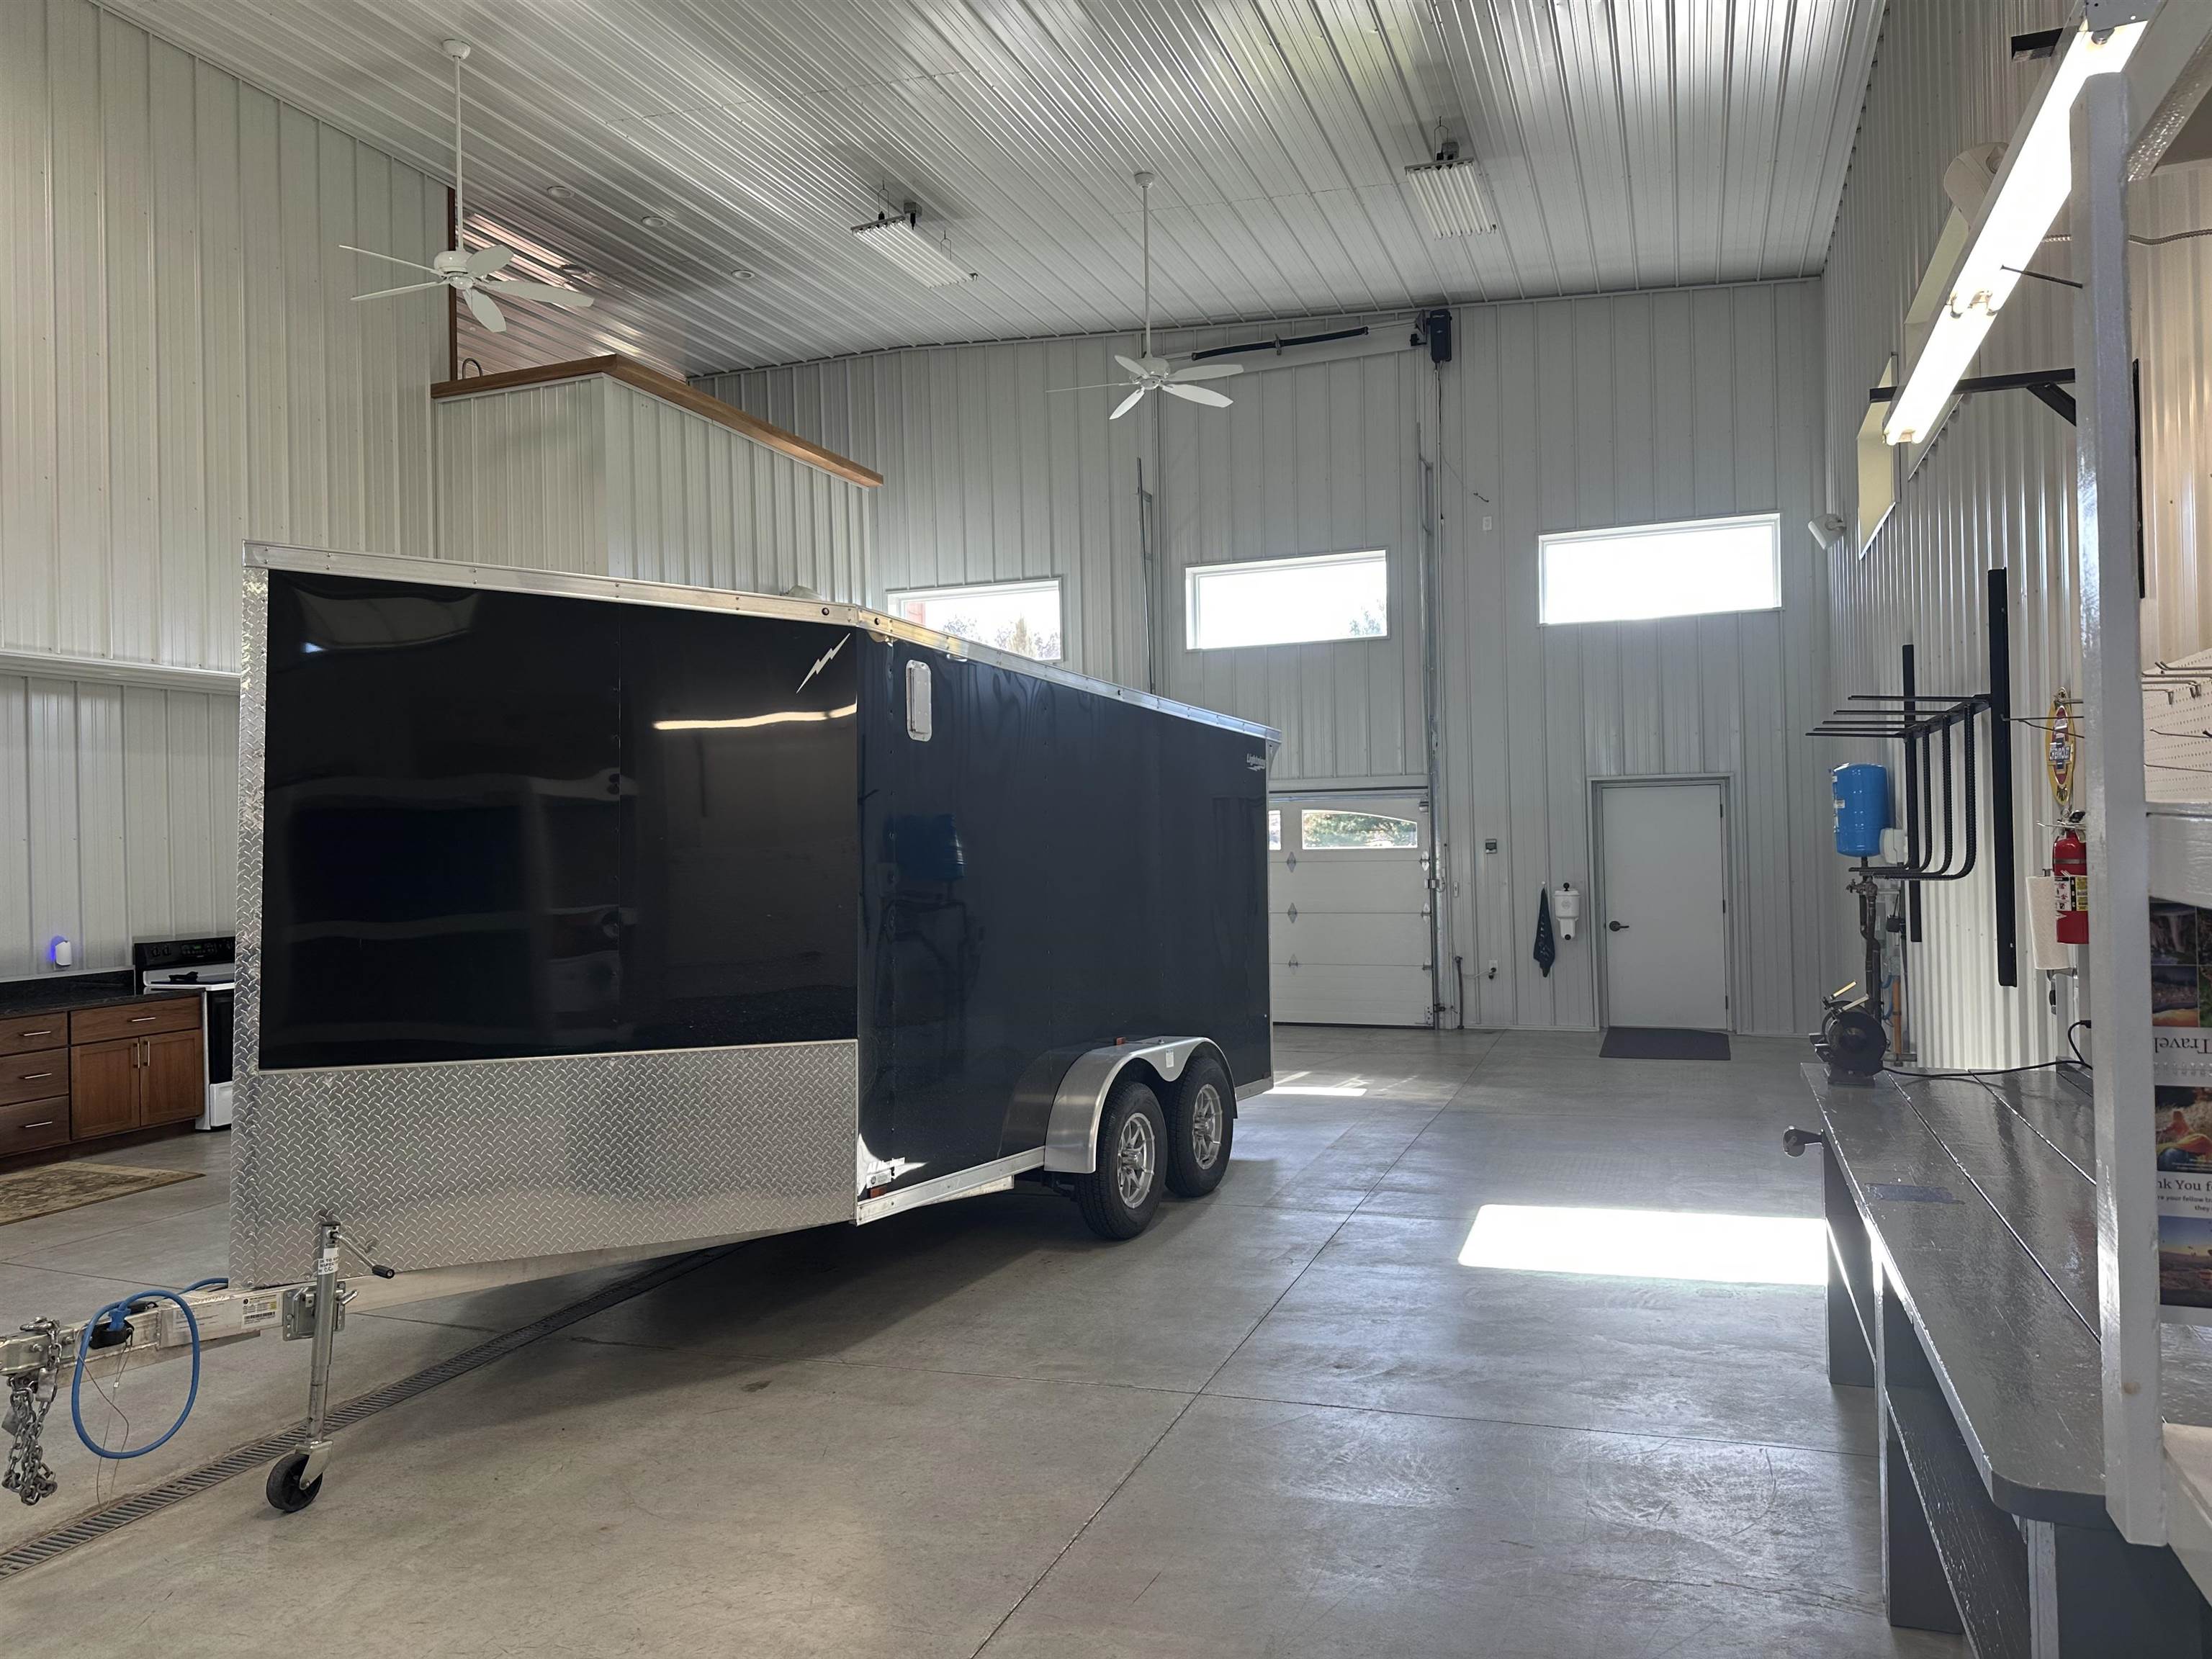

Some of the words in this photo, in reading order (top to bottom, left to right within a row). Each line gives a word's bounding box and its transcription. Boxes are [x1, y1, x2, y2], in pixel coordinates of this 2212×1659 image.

[2154, 1038, 2212, 1054] Travel
[2175, 1179, 2201, 1191] You
[2206, 1181, 2212, 1192] f
